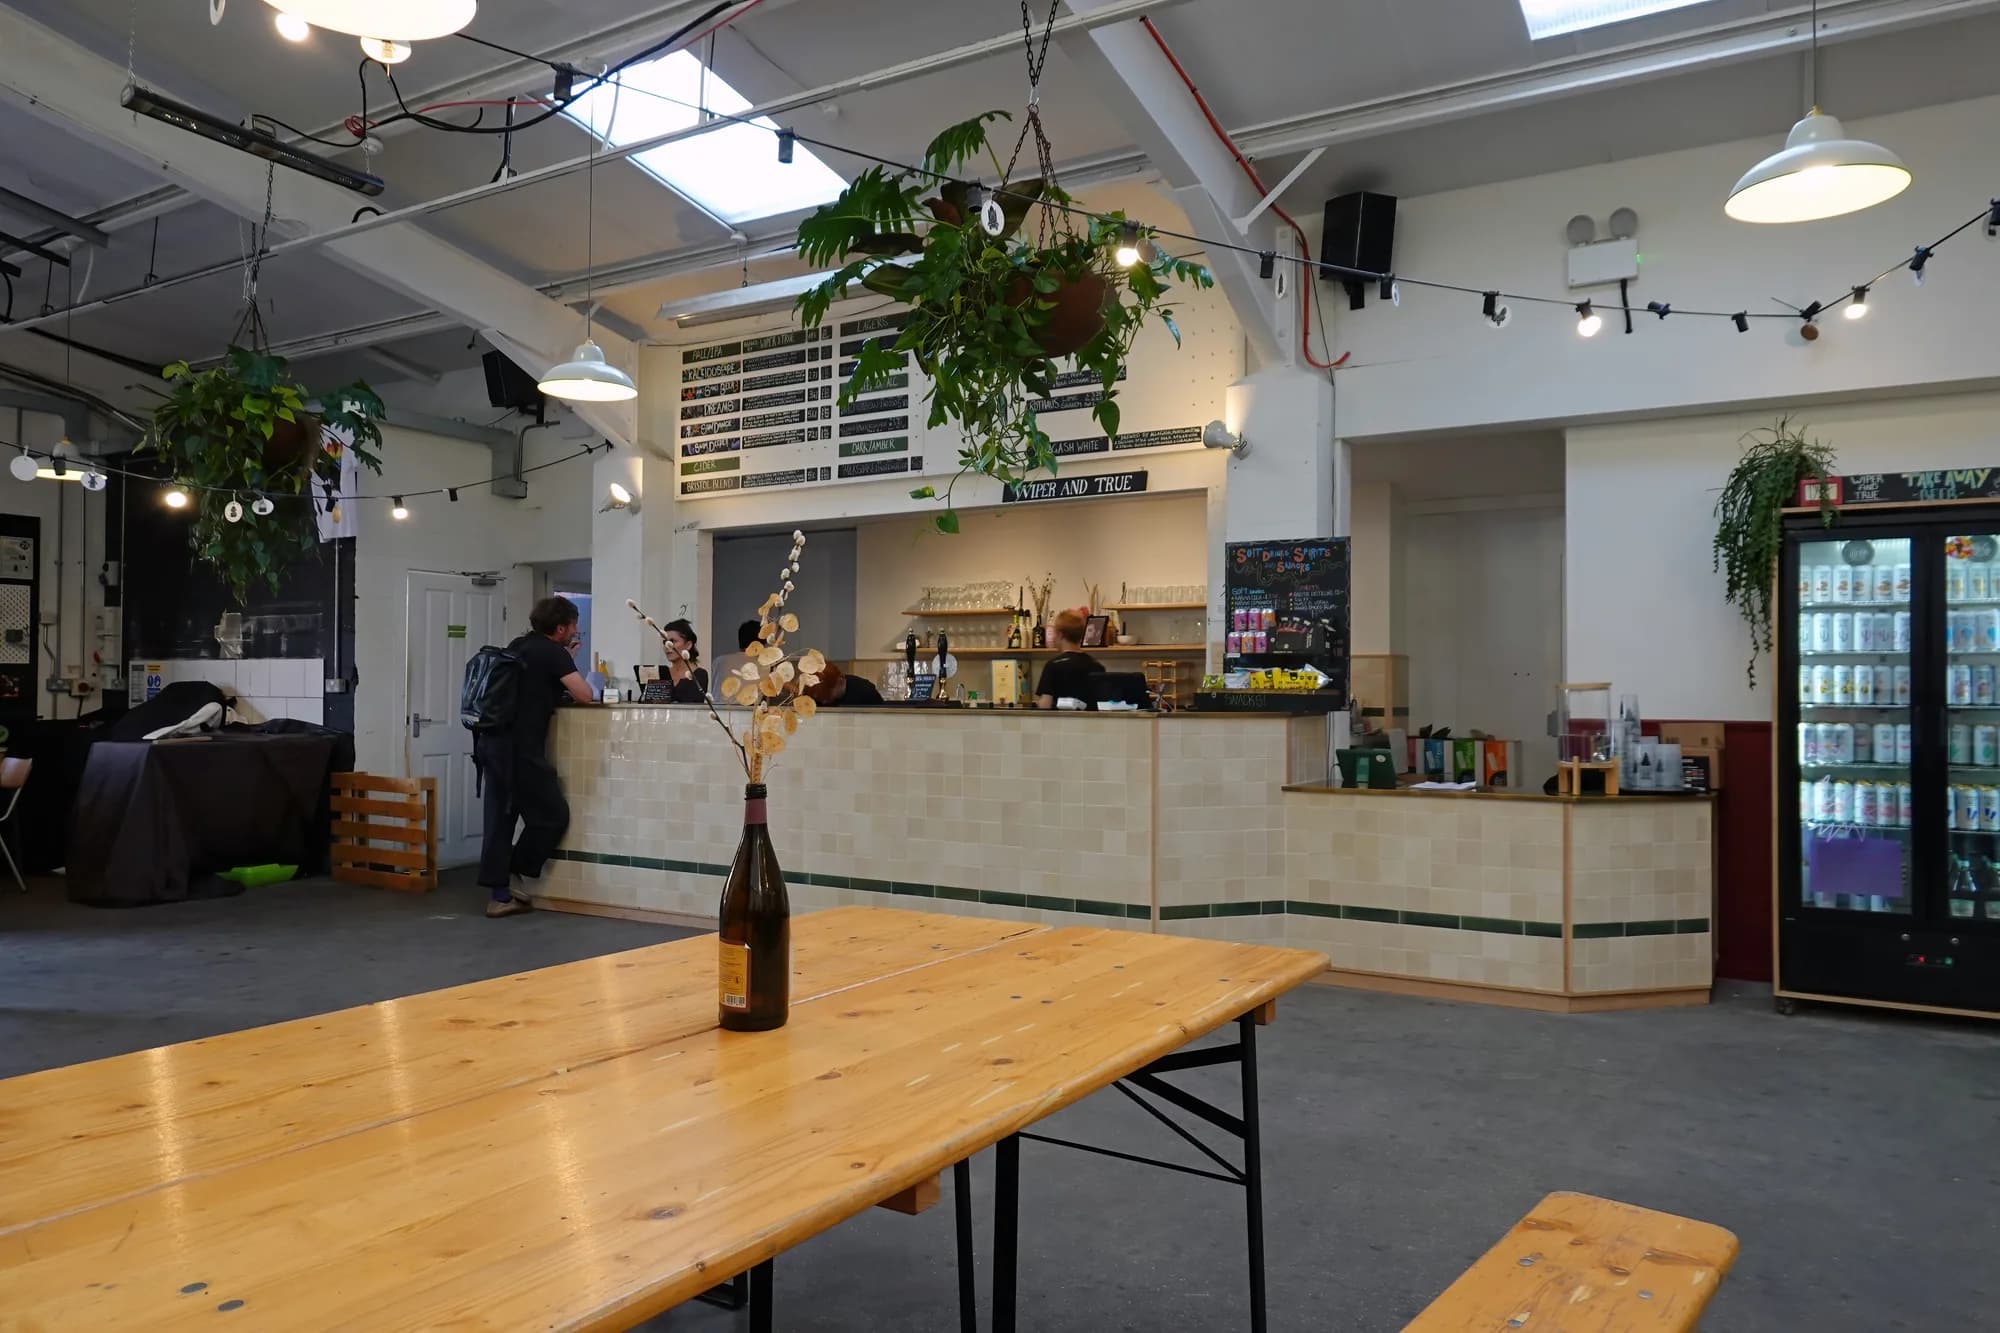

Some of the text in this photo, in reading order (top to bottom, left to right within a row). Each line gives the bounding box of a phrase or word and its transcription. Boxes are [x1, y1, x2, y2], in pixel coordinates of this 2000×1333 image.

[1076, 440, 1099, 452] WHITE
[1015, 475, 1132, 500] WIPER AND TRUE
[1901, 471, 1942, 489] TAKE
[1944, 467, 1992, 489] AWAY
